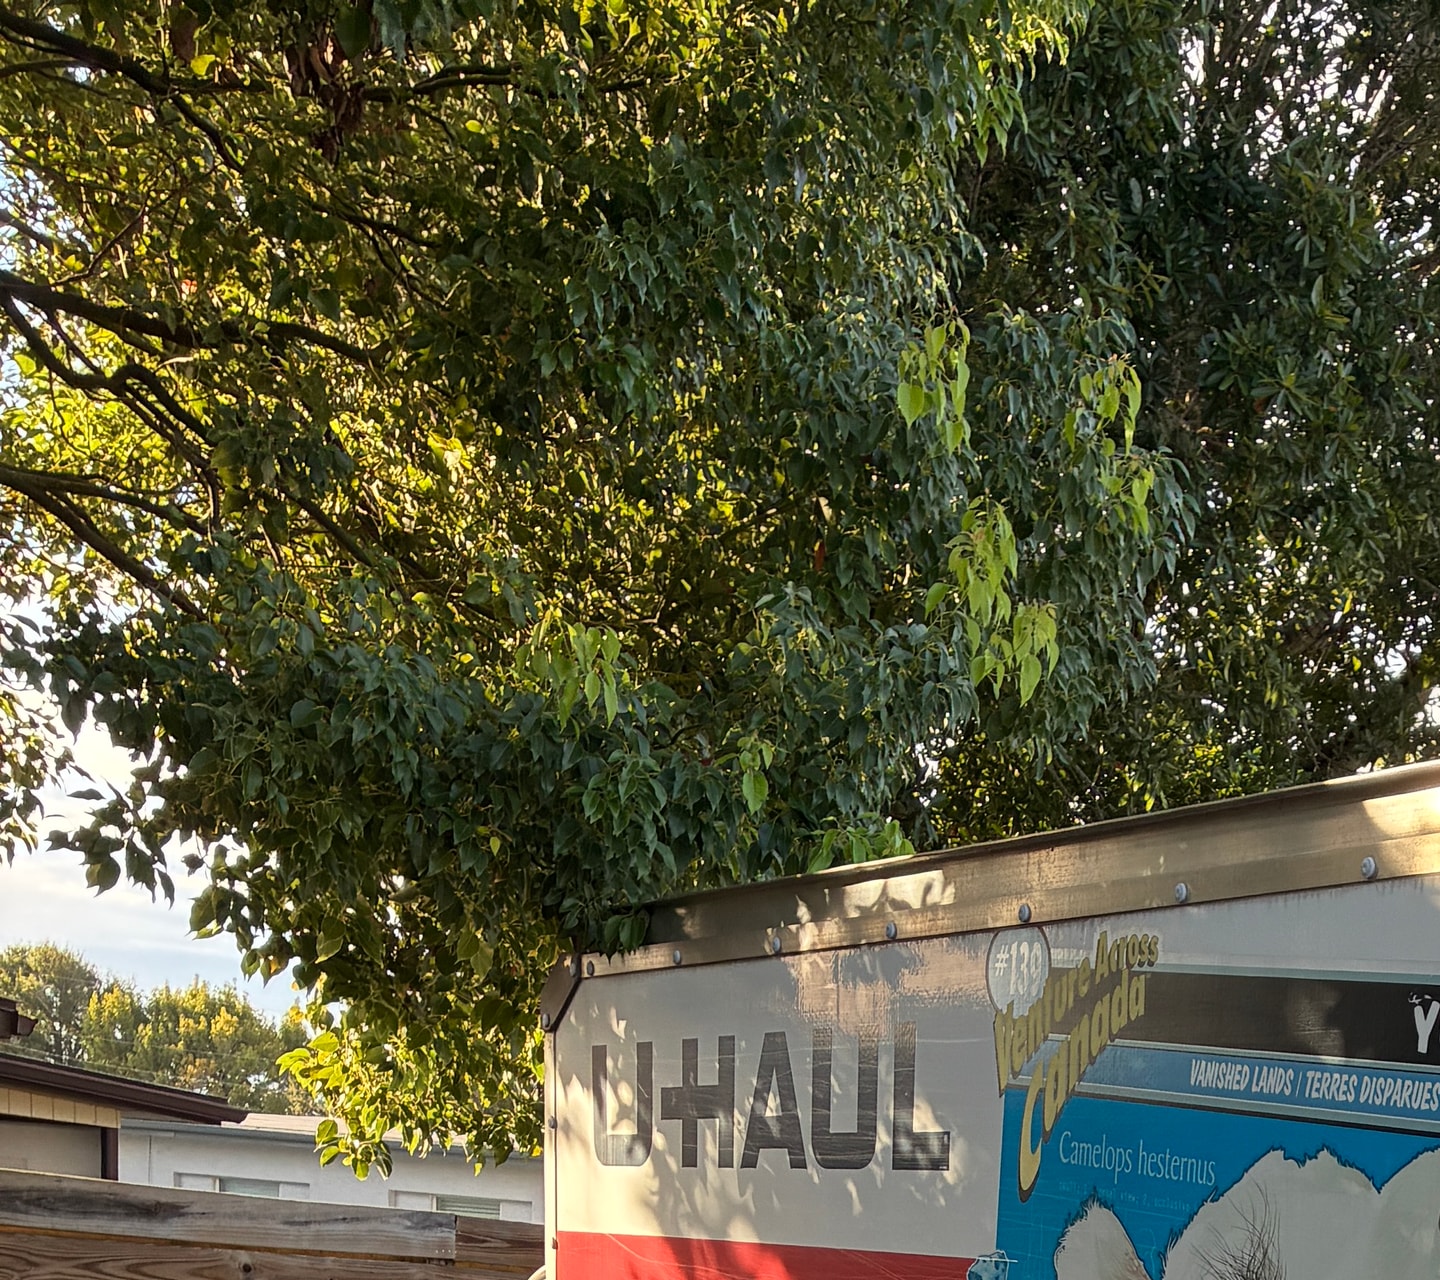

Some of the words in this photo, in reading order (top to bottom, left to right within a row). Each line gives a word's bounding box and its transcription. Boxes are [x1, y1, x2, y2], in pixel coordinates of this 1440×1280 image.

[994, 956, 1091, 1097] Venture
[1095, 930, 1159, 985] Across
[995, 940, 1042, 996] #139
[591, 1022, 951, 1171] U-HAUL
[1017, 968, 1147, 1203] Canada
[1189, 1058, 1250, 1092] VANISHED
[1252, 1066, 1293, 1096] LANDS
[1305, 1070, 1358, 1103] TERRES
[1360, 1077, 1440, 1112] DISPARUES
[1058, 1129, 1133, 1184] Camelops
[1138, 1139, 1216, 1187] hesternus
